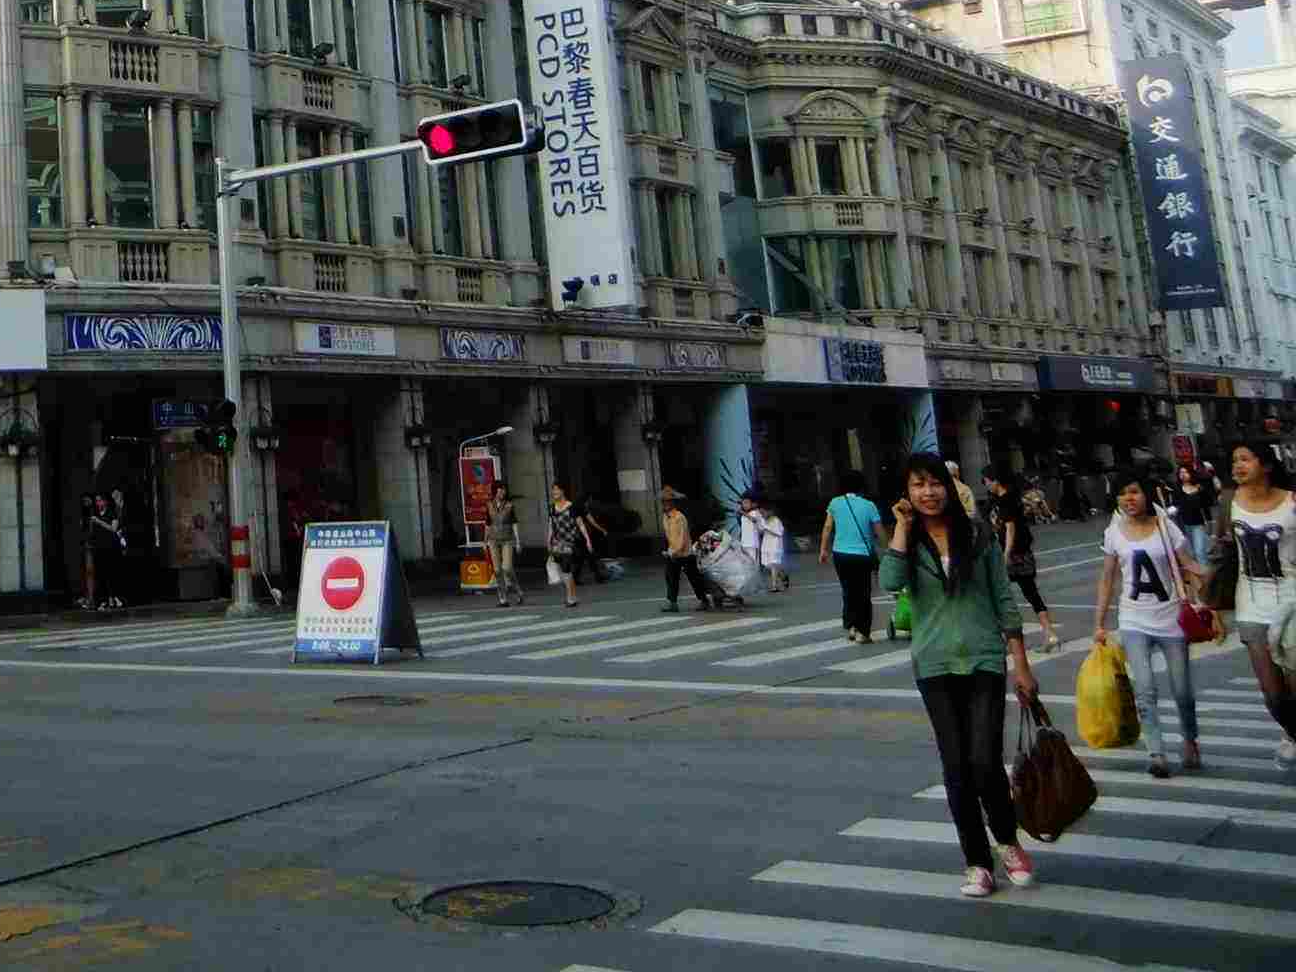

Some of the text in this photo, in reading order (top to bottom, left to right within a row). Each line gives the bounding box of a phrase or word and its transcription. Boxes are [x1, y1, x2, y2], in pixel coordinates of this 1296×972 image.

[533, 12, 576, 218] PCD STORES
[560, 7, 607, 216] 巴黎春天百货
[1148, 115, 1199, 259] 交通銀行
[1132, 549, 1171, 603] A
